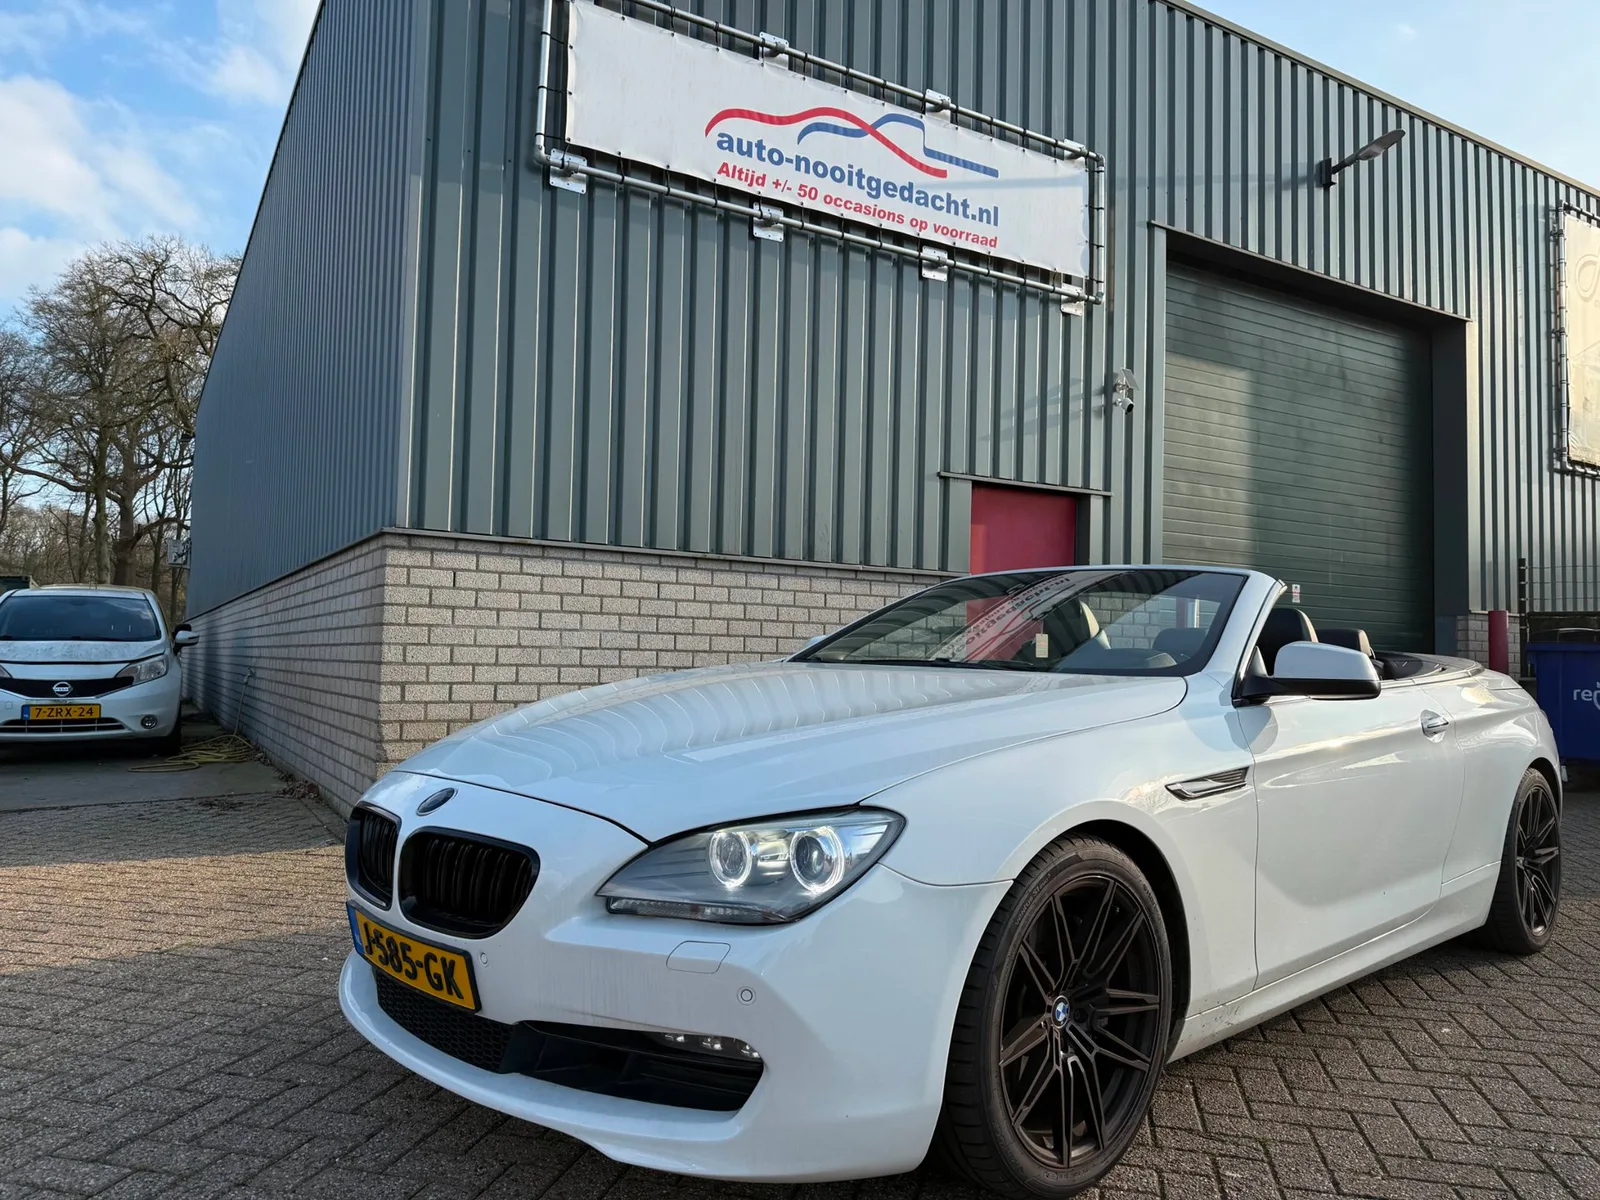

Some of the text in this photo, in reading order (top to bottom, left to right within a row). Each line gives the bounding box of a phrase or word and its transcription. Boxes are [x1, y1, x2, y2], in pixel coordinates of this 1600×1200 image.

[716, 132, 999, 227] auto-nooitgedacht.nl
[717, 161, 998, 248] Altijd +/- 50 occasions op voorraad
[35, 707, 94, 718] 7-ZRX-24
[363, 922, 464, 1000] J-585-GK
